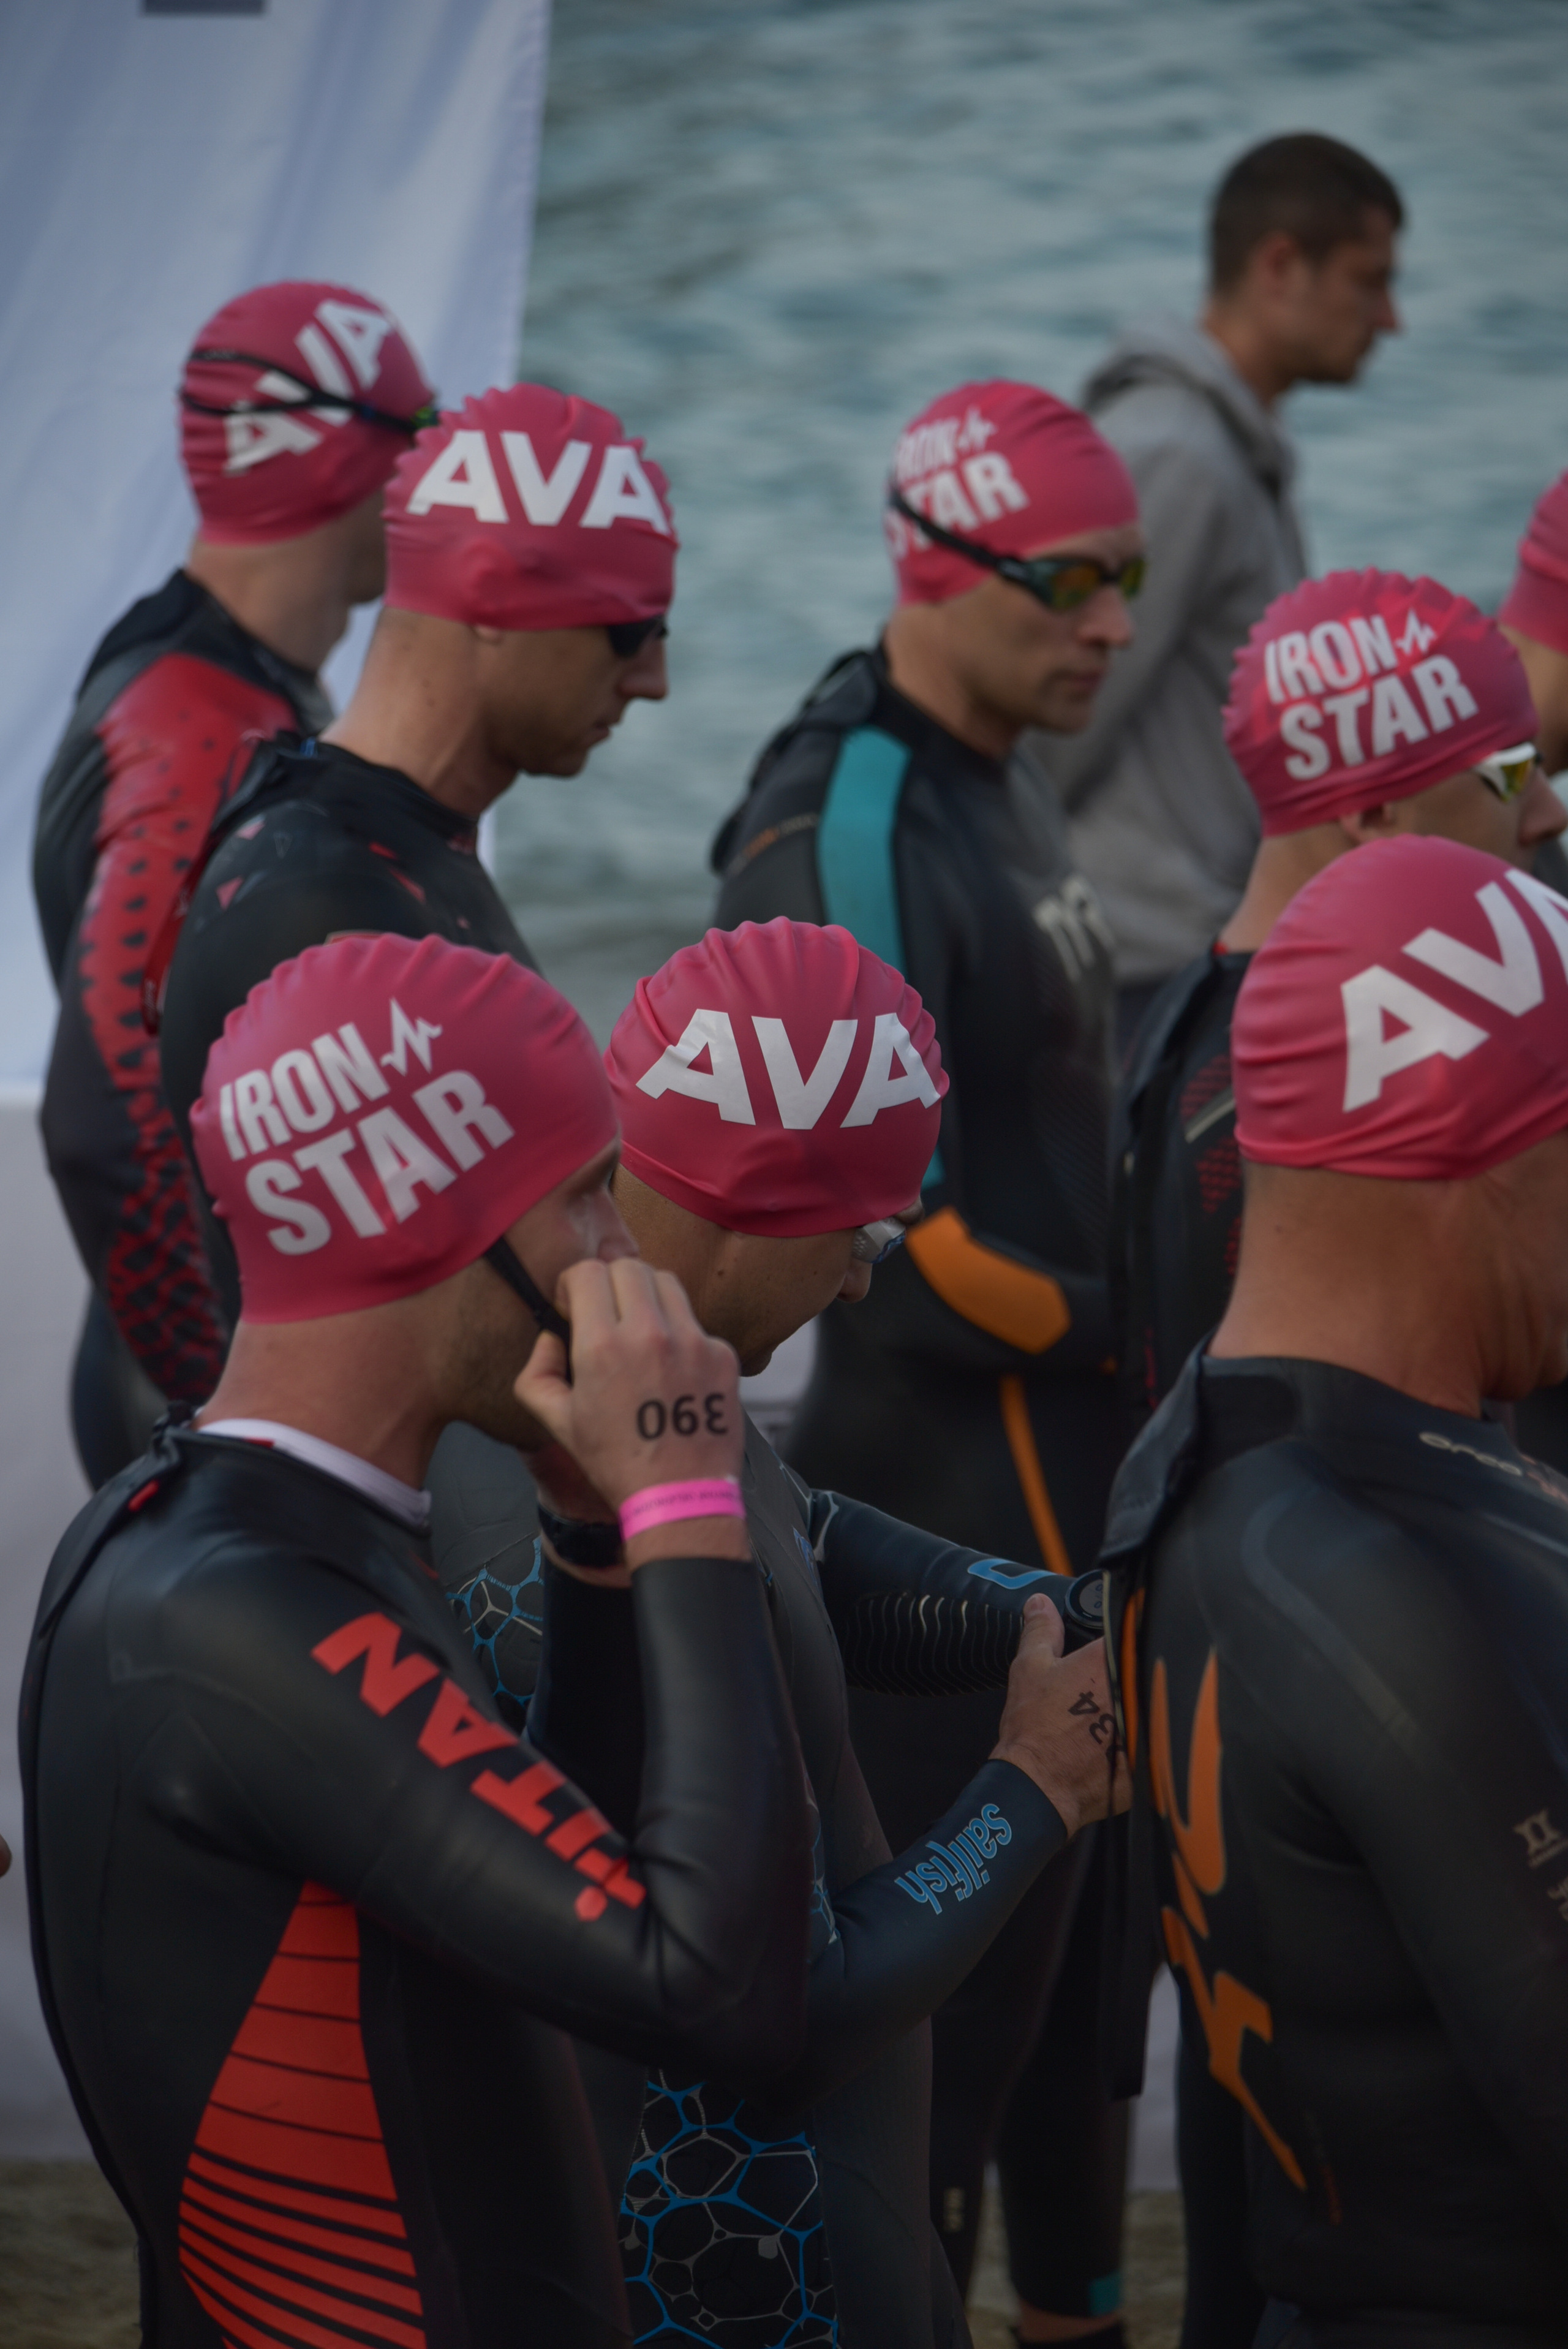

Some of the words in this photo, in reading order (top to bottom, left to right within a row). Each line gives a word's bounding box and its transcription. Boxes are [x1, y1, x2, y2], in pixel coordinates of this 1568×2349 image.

[406, 429, 669, 535] AVA
[1264, 613, 1398, 704] IRON
[1280, 654, 1480, 781] STAR
[219, 1021, 391, 1162] IRON
[635, 1008, 941, 1130] AVA
[245, 1069, 516, 1256] STAR
[636, 1391, 729, 1440] 390
[894, 1803, 1012, 1915] sailfish
